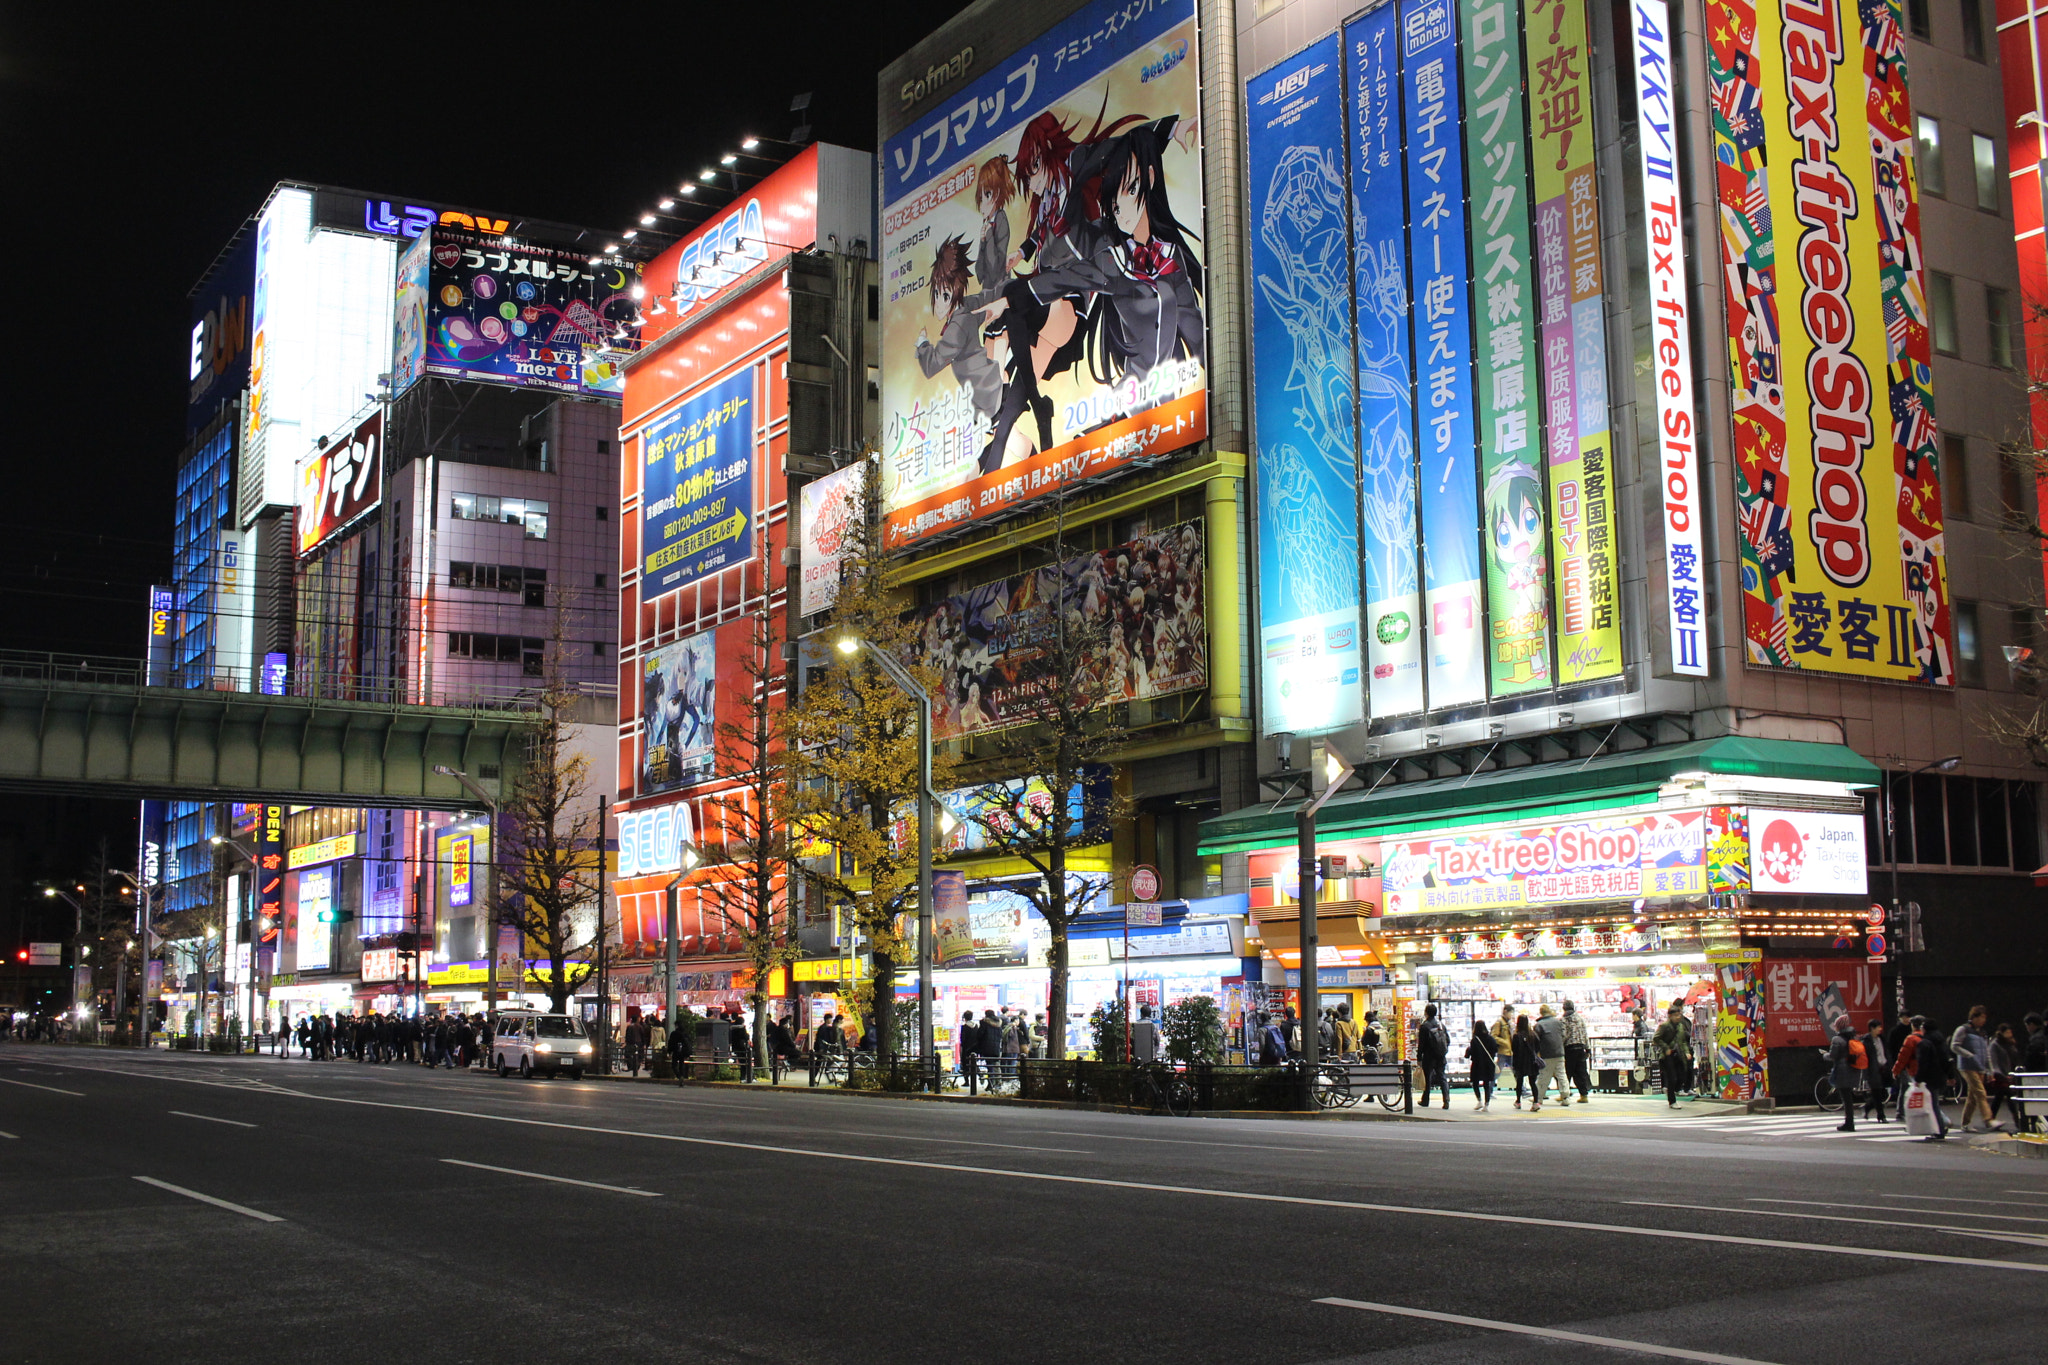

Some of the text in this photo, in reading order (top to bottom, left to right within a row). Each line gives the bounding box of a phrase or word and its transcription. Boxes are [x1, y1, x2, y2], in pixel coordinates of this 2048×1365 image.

[1410, 21, 1447, 51] money
[900, 46, 974, 112] Sofmap
[1273, 66, 1311, 103] Hey
[1373, 27, 1391, 168] ゲームセンターを
[1636, 3, 1670, 151] AKKY
[893, 53, 1039, 184] ソフマップ
[885, 166, 976, 235] みなとそふと完全新作
[1471, 0, 1527, 455] ロンブックス秋葉原店
[1569, 173, 1598, 294] 货比三家
[433, 231, 474, 246] ADULT
[478, 237, 554, 258] AMUSEMENT
[461, 248, 596, 283] ラブメルシー
[676, 197, 769, 318] SEGA
[1650, 195, 1685, 398] Tax-free
[1783, 0, 1868, 579] Tax-free Shop
[1663, 408, 1692, 533] Shop
[1557, 480, 1586, 637] DUTY FREE
[1492, 611, 1547, 640] このビル
[1497, 636, 1545, 664] 地下1F
[619, 805, 690, 874] SEGA
[1434, 829, 1638, 875] Tax-free Shop
[1815, 847, 1860, 863] Tax-free
[1832, 866, 1860, 882] Shop
[1869, 909, 1881, 921] 20
[1768, 963, 1880, 1011] 貸ホール
